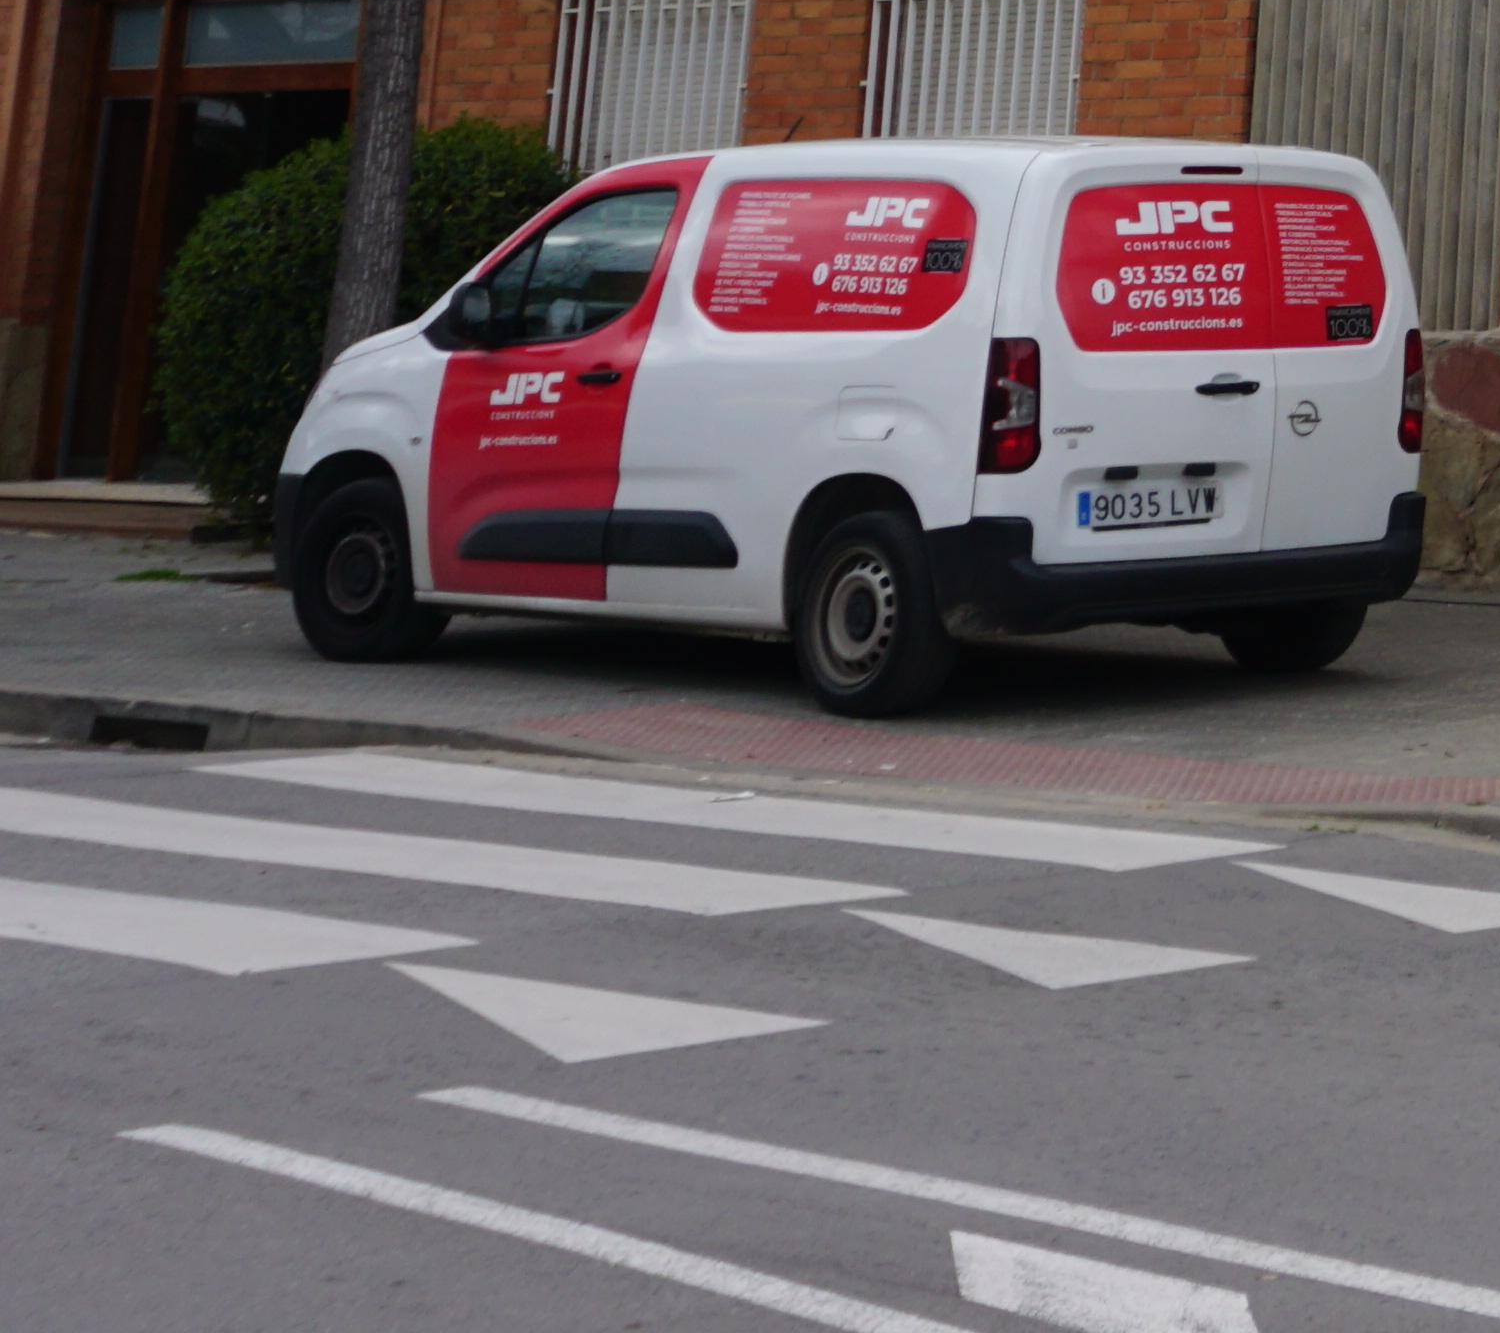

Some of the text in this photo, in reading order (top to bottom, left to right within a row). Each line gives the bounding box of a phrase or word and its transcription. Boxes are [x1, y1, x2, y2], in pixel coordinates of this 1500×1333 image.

[845, 197, 930, 229] JPC
[1115, 200, 1234, 236] JPC
[844, 233, 916, 244] CONSTRUCCIONS
[1123, 239, 1231, 253] CONSTRUCCIONS
[833, 253, 918, 274] 93 352 62 67
[926, 252, 962, 269] 100%
[1119, 263, 1245, 285] 93 352 62 67
[832, 275, 908, 295] 676 913 126
[815, 299, 902, 316] jpc-construccions.es
[1127, 287, 1242, 309] 676 913 126
[1110, 317, 1243, 338] jpc-construccions.es
[1329, 318, 1371, 337] 100%
[489, 371, 565, 406] JPC
[489, 409, 555, 421] CONSTRUCCIONS
[479, 435, 558, 450] jpc-construccions.es
[1094, 486, 1216, 521] 9035 LVW
